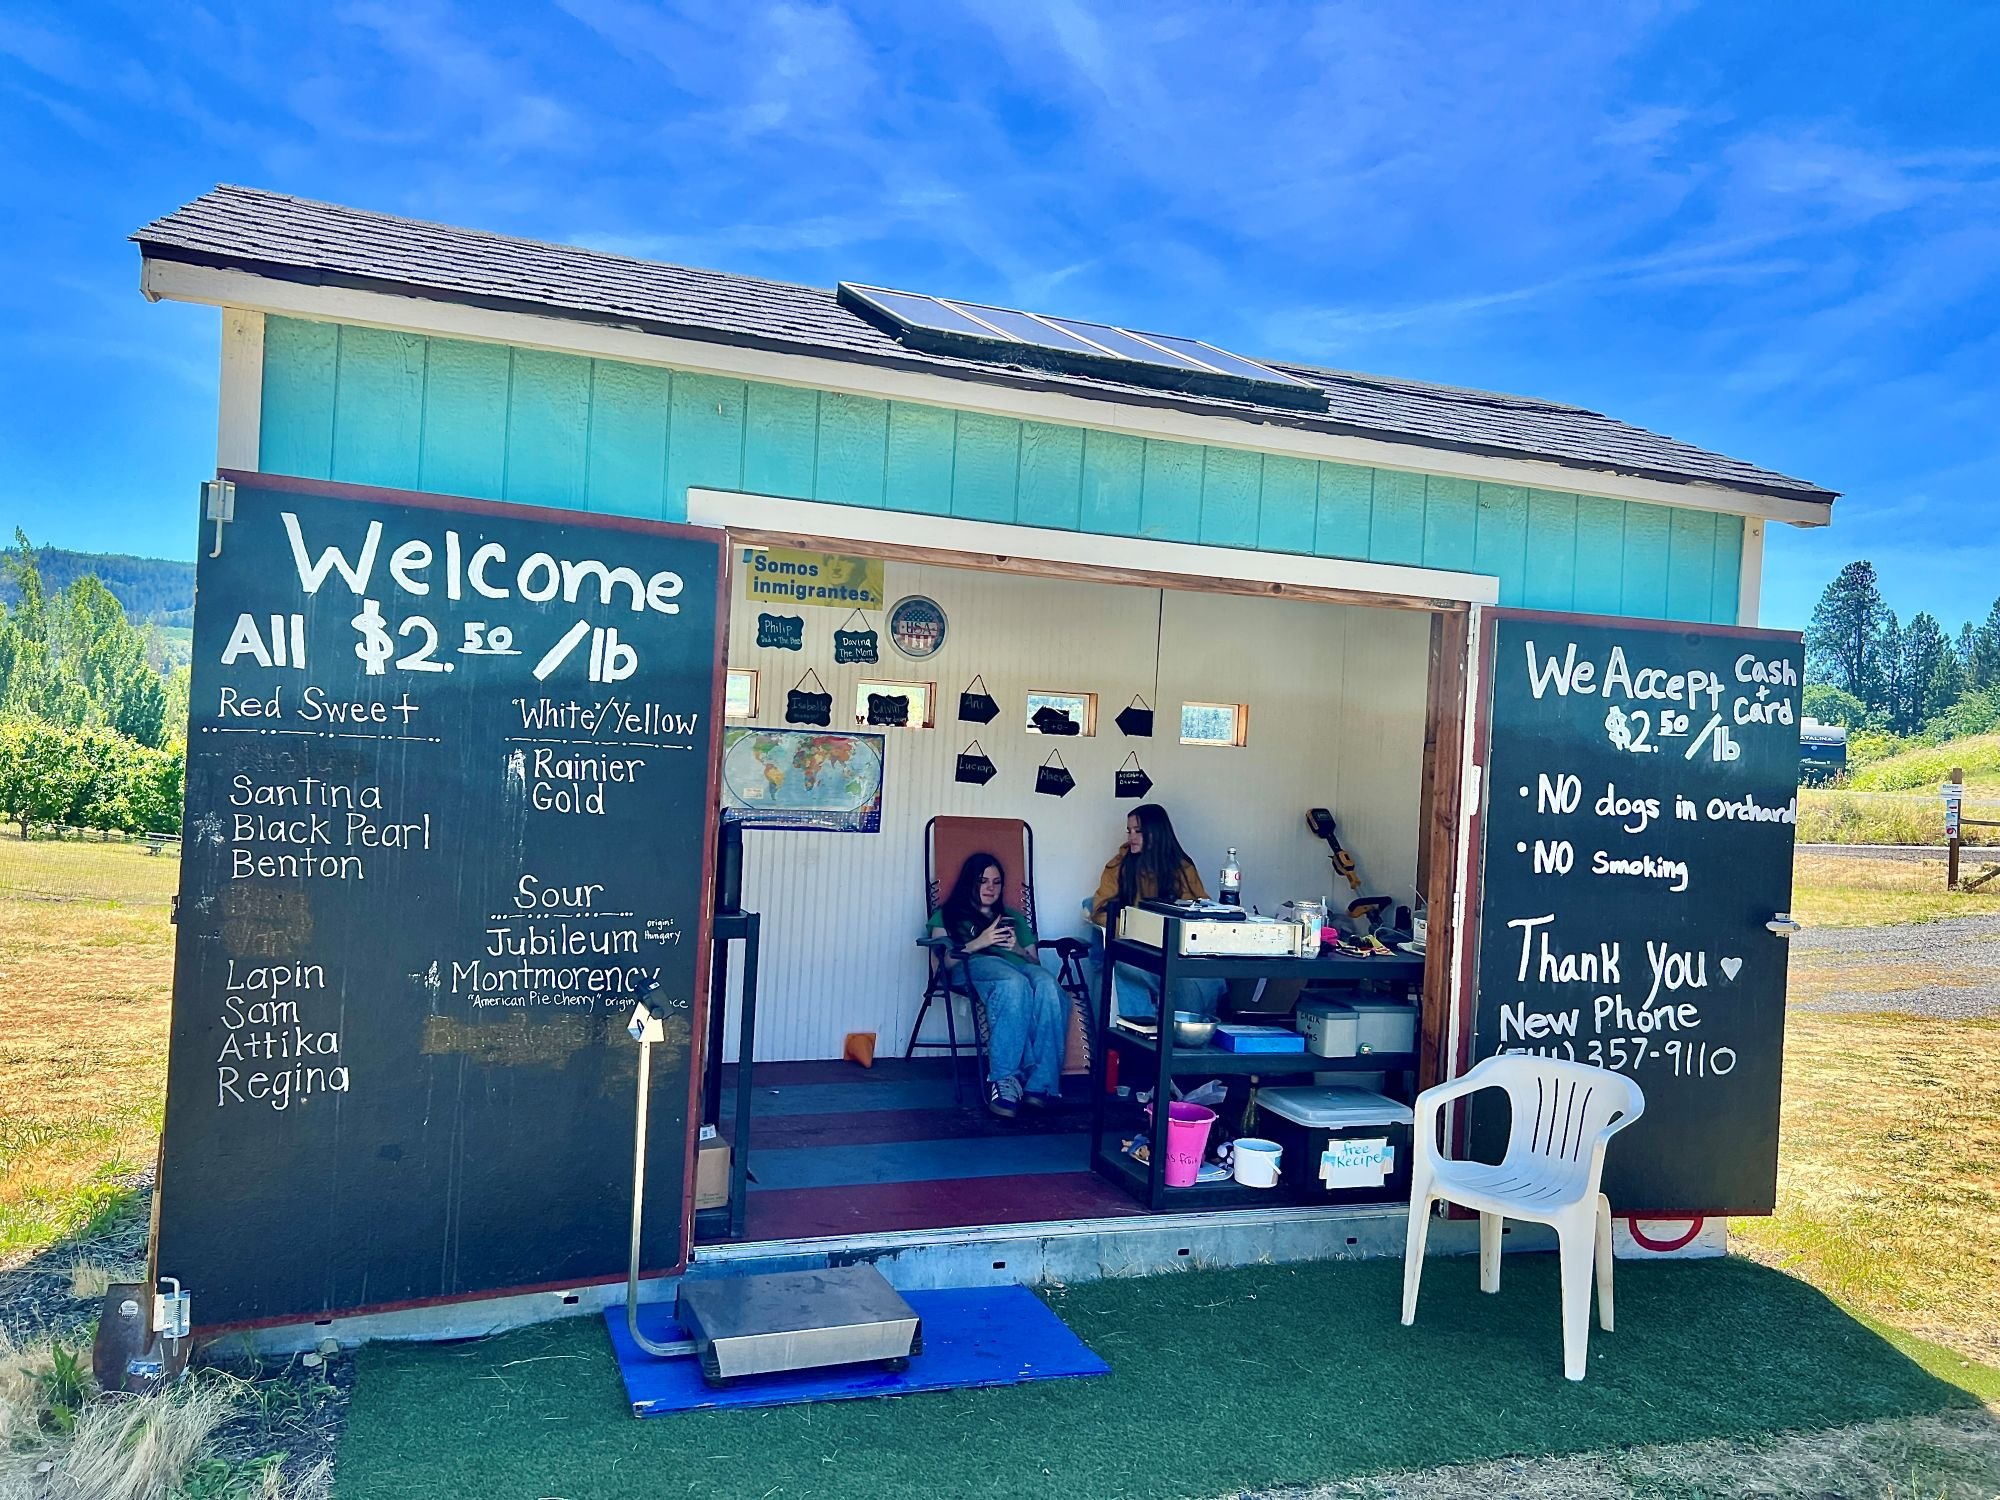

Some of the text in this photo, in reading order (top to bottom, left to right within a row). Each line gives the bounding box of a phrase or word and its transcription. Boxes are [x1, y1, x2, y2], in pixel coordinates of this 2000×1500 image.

[281, 512, 684, 614] Welcome
[755, 555, 818, 576] Somos
[753, 576, 875, 602] inmigrantes.
[221, 614, 305, 669] All
[764, 619, 793, 636] Philip
[905, 621, 932, 635] USA
[840, 647, 874, 658] The Mom
[1526, 641, 1725, 711] We Accept
[1735, 654, 1797, 687] Cash
[218, 686, 419, 723] Red Sweet
[1734, 697, 1794, 726] Card
[534, 749, 645, 784] Rainier
[230, 775, 382, 809] Santina
[533, 784, 605, 814] Gold
[1538, 774, 1581, 814] NO
[1595, 783, 1660, 833] dogs
[1675, 795, 1697, 820] in
[232, 813, 430, 849] Black Pearl
[232, 848, 364, 879] Benton
[1534, 840, 1573, 873] NO
[514, 875, 604, 908] Sour
[487, 923, 638, 956] Jubileum
[645, 930, 681, 945] Hungary
[1508, 914, 1620, 983] Thank
[227, 960, 325, 1000] Lapin
[221, 995, 300, 1029] Sam
[529, 991, 551, 1006] Pie
[1501, 994, 1701, 1041] New Phone
[218, 1028, 338, 1062] Attika
[1587, 1038, 1736, 1078] 357-9110
[218, 1063, 349, 1110] Regina
